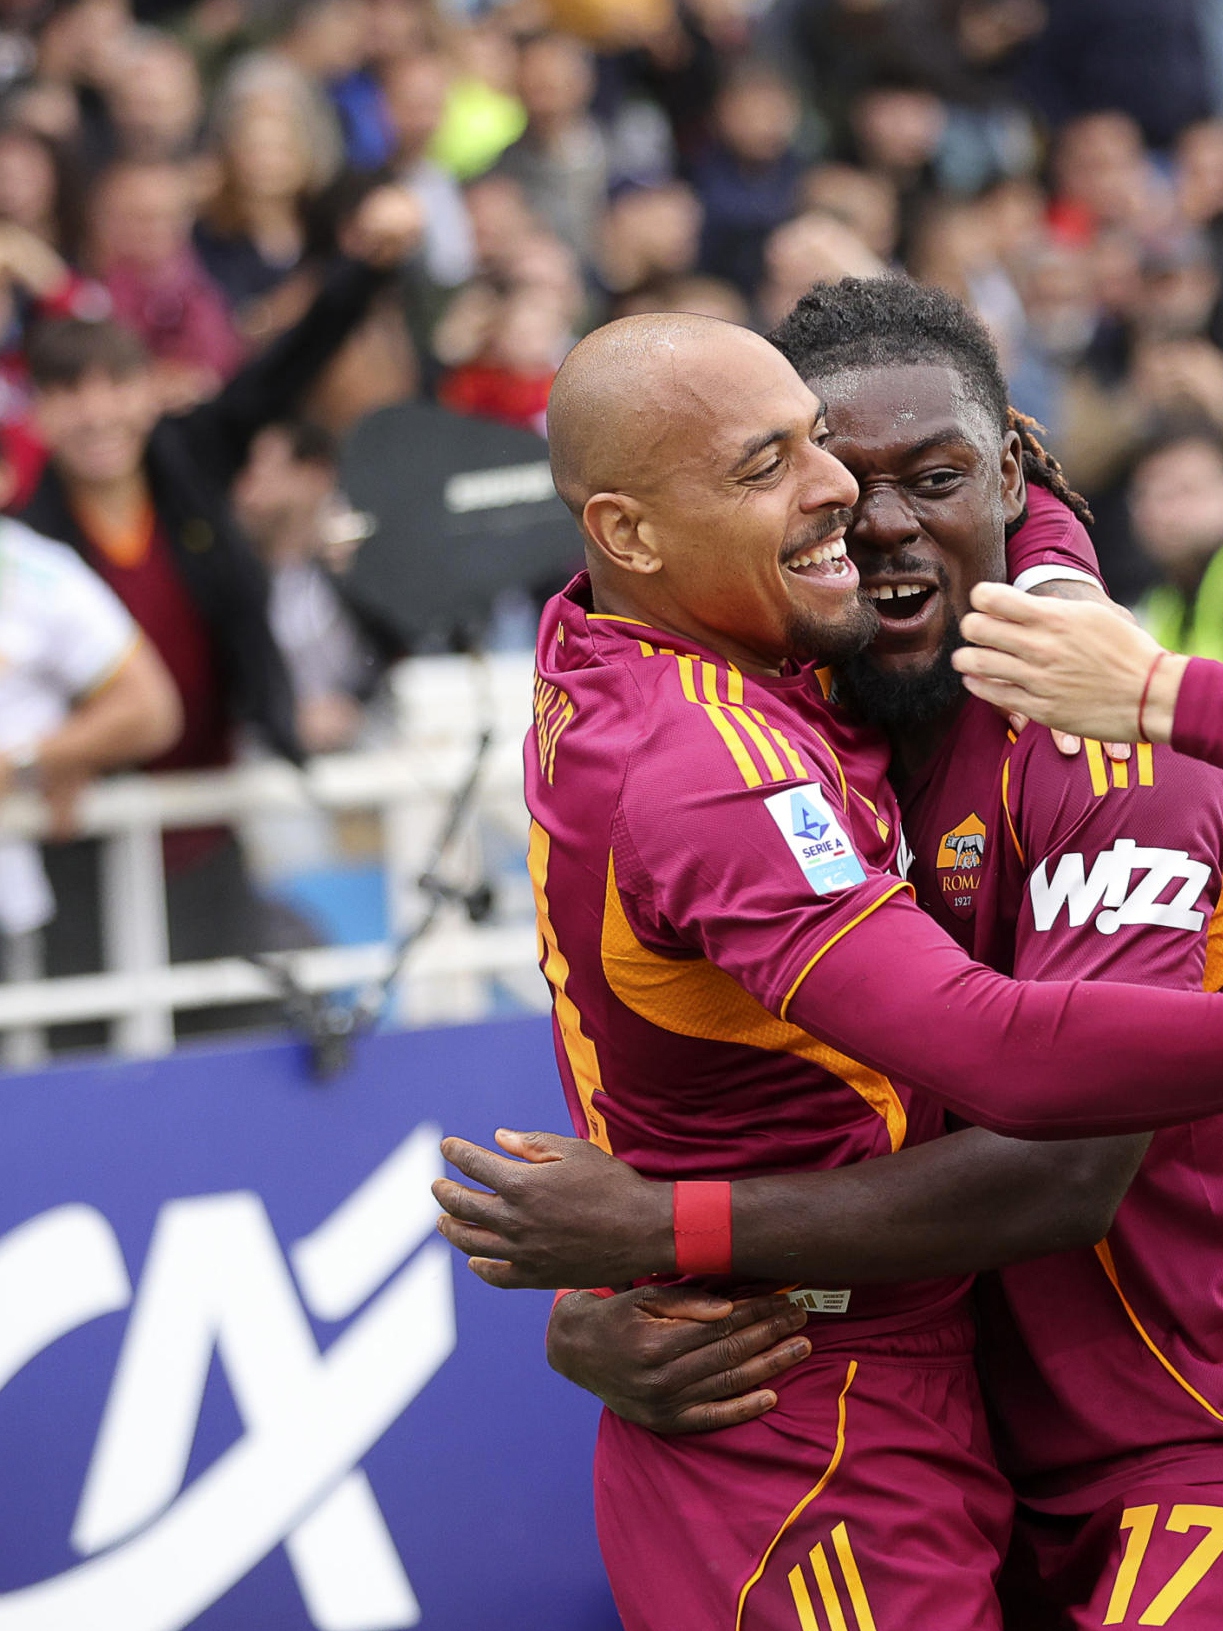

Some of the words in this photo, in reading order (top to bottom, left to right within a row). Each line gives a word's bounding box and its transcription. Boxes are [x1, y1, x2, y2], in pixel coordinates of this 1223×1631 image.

[802, 841, 834, 859] SERIE
[835, 838, 844, 849] A
[954, 896, 972, 907] 1927
